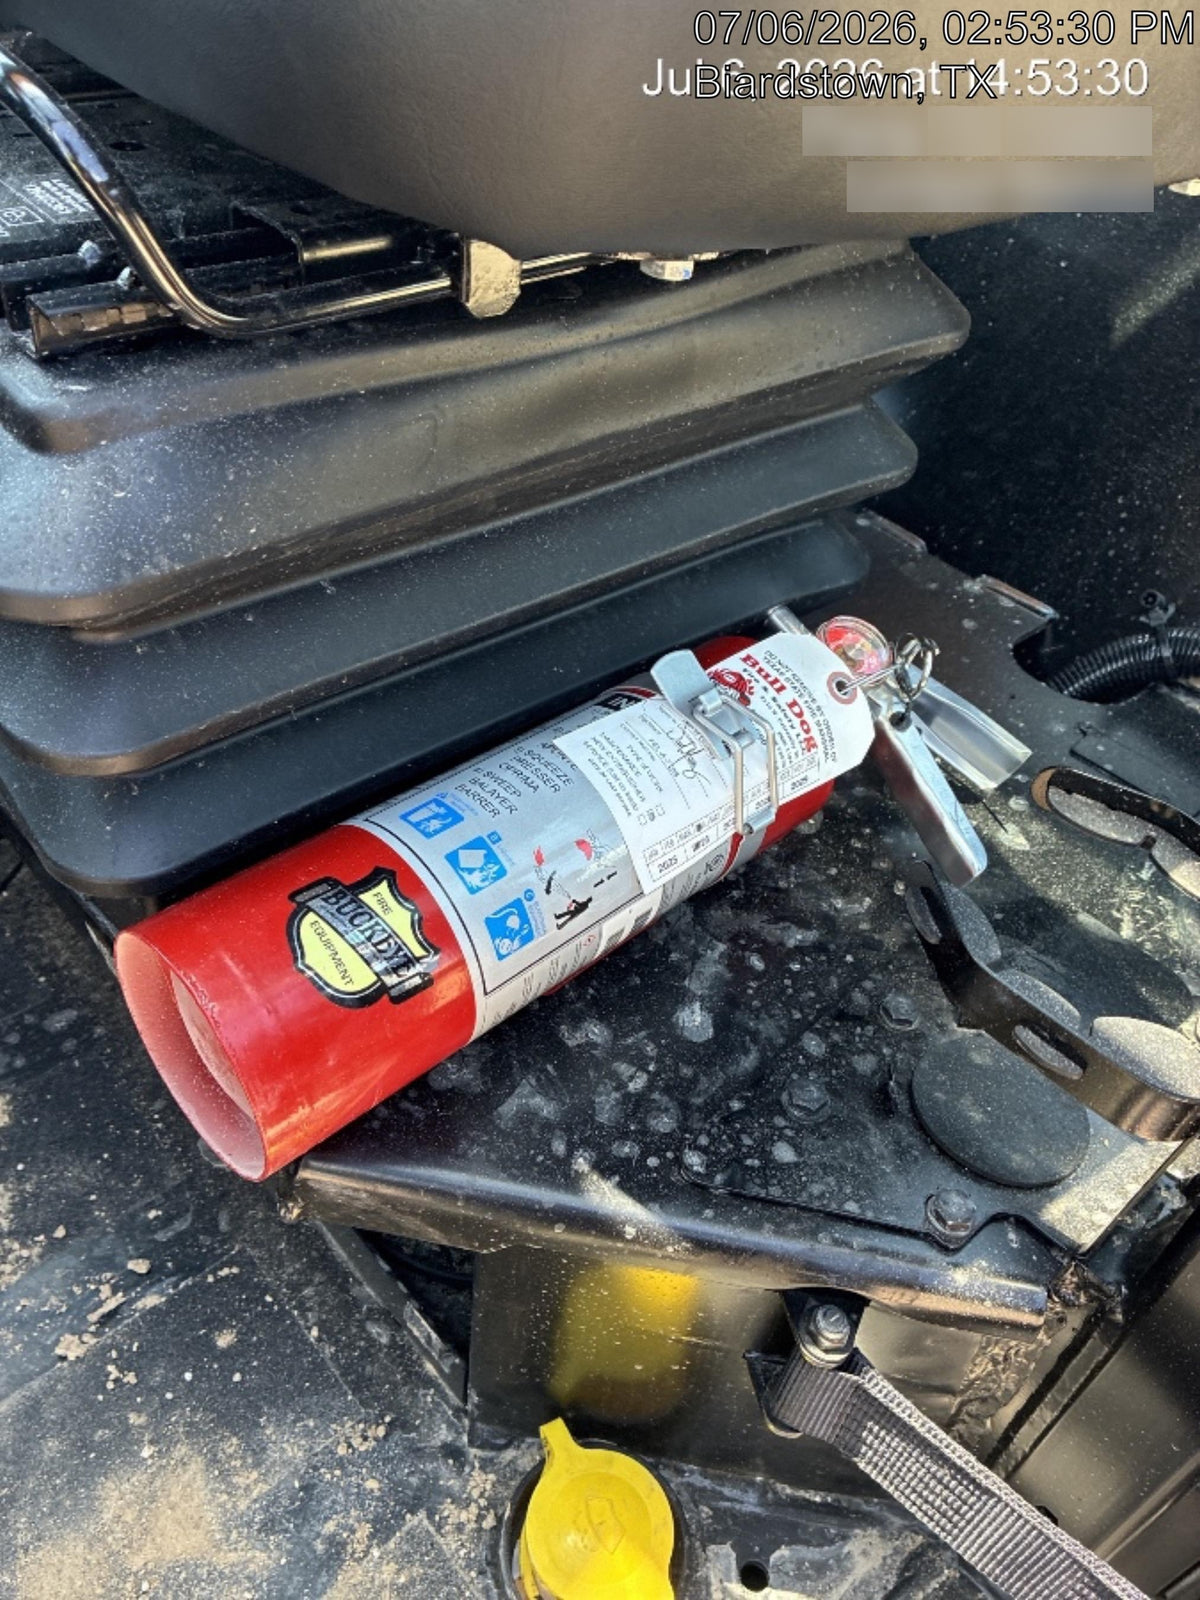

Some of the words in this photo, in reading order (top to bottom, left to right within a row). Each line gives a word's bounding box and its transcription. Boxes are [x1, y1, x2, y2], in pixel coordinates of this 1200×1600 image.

[740, 654, 788, 693] Bull
[786, 698, 818, 753] Dog
[321, 885, 416, 979] BUCKEYE
[372, 891, 393, 916] FIRE
[309, 919, 353, 986] EQUIPMENT
